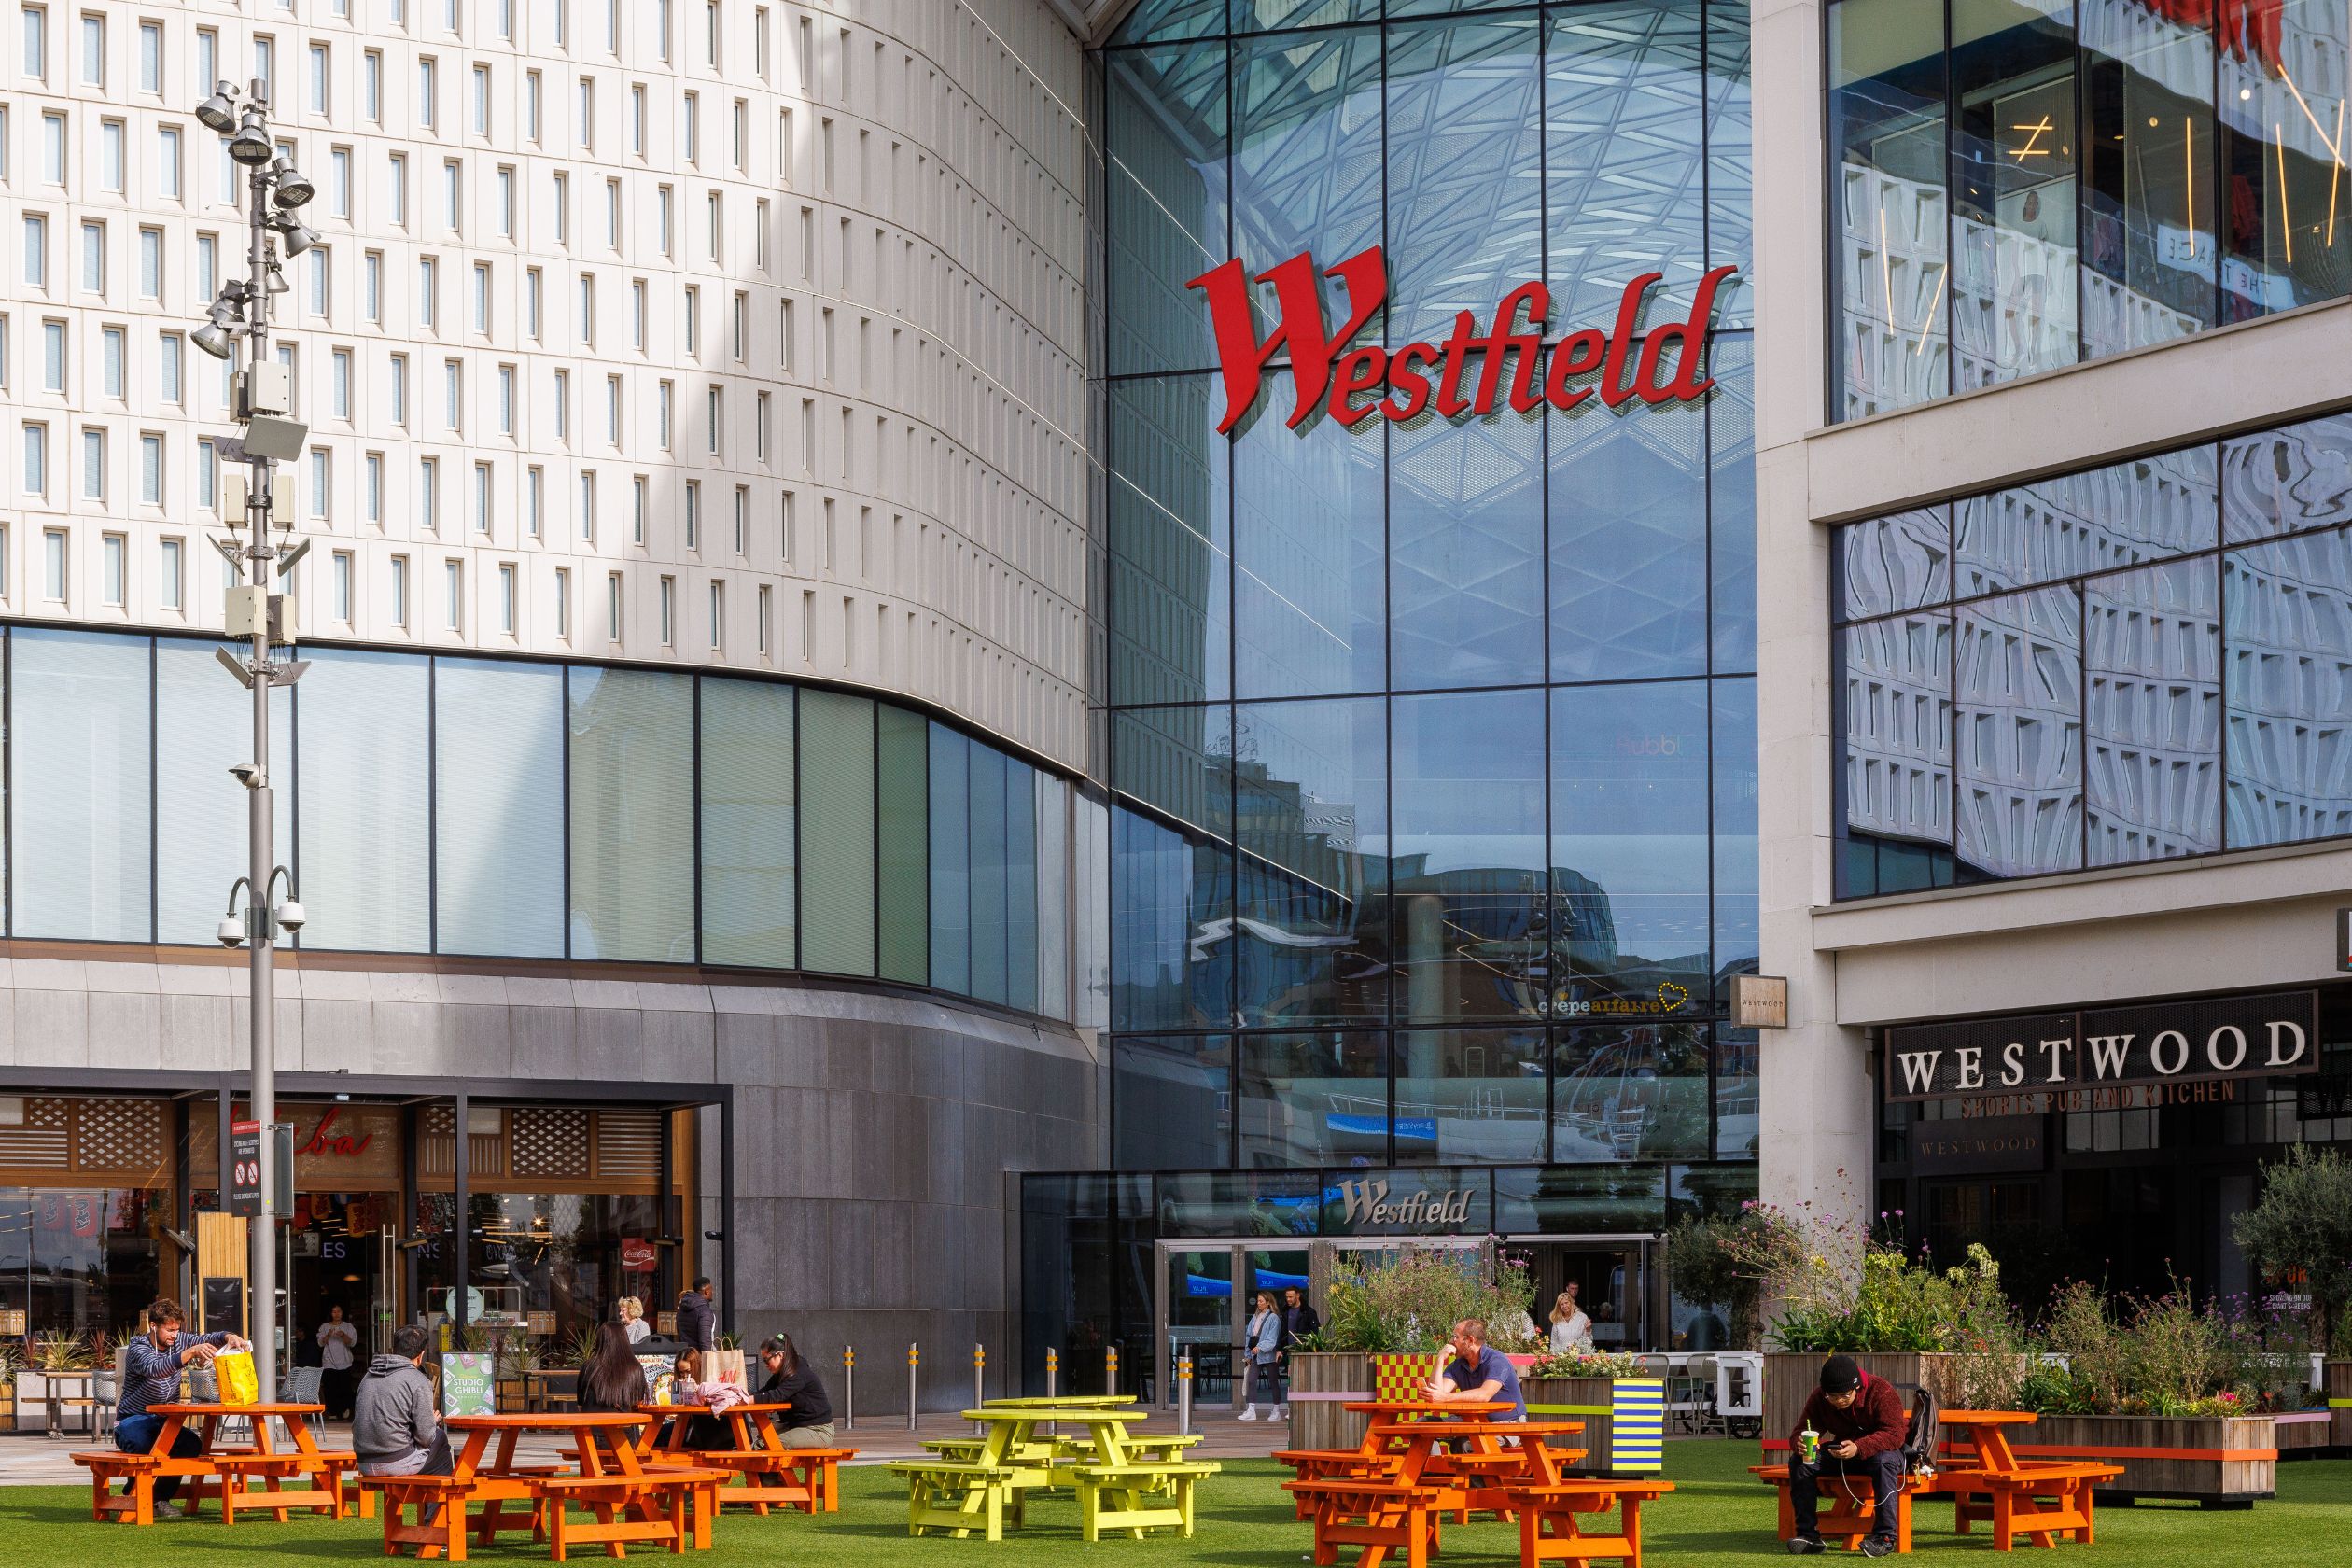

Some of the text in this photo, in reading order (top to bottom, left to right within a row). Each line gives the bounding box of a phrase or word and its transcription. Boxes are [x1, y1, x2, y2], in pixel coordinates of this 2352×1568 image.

[1185, 245, 1739, 437] Westfield
[1742, 999, 1784, 1008] WESTWOOD
[1897, 1021, 2305, 1094] WESTWOOD
[1962, 1079, 2235, 1119] SPORTS PUB AND KITCHEN
[1921, 1135, 2037, 1157] WESTWOOD
[1337, 1179, 1476, 1225] Westfield
